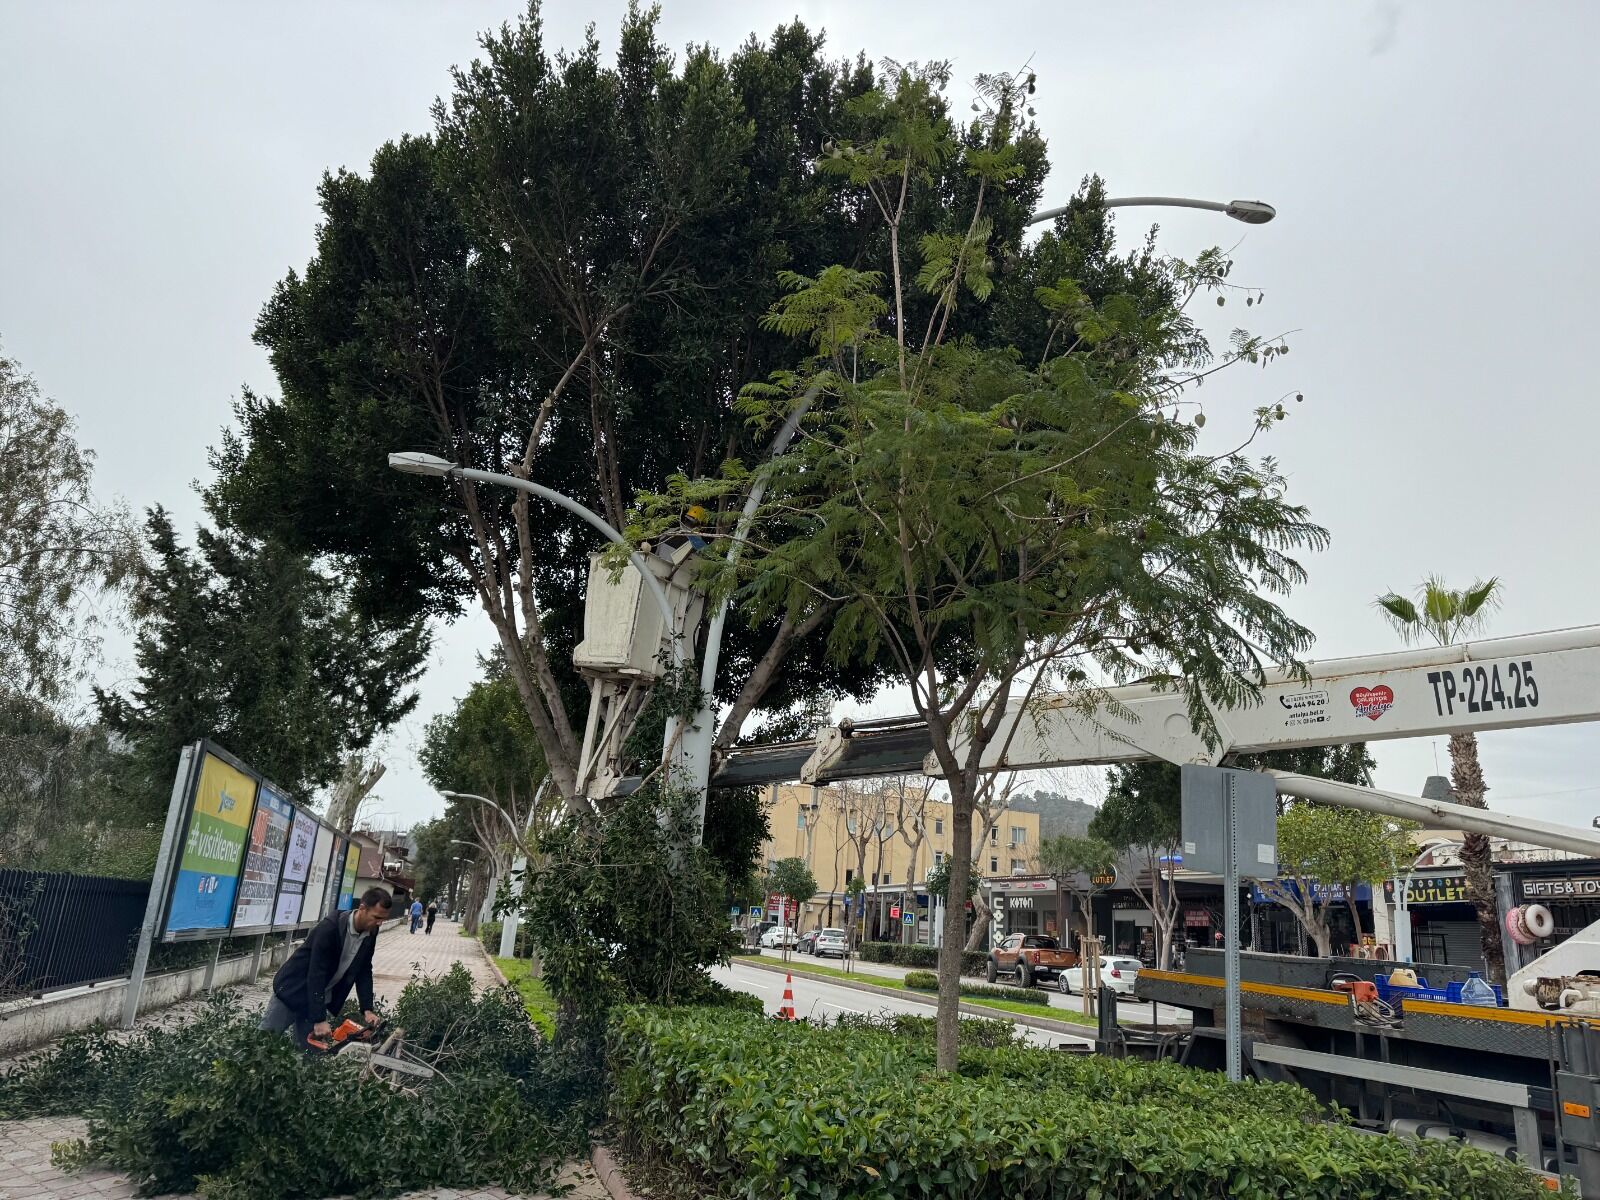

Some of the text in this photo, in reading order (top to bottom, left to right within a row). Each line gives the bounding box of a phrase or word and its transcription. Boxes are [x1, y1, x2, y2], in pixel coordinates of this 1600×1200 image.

[1427, 660, 1538, 716] TP-224.25
[1356, 702, 1392, 713] Antalya
[188, 821, 241, 864] #visitkemer
[1407, 887, 1465, 901] OUTLET
[1523, 882, 1564, 895] GIFTS
[1565, 881, 1575, 893] &
